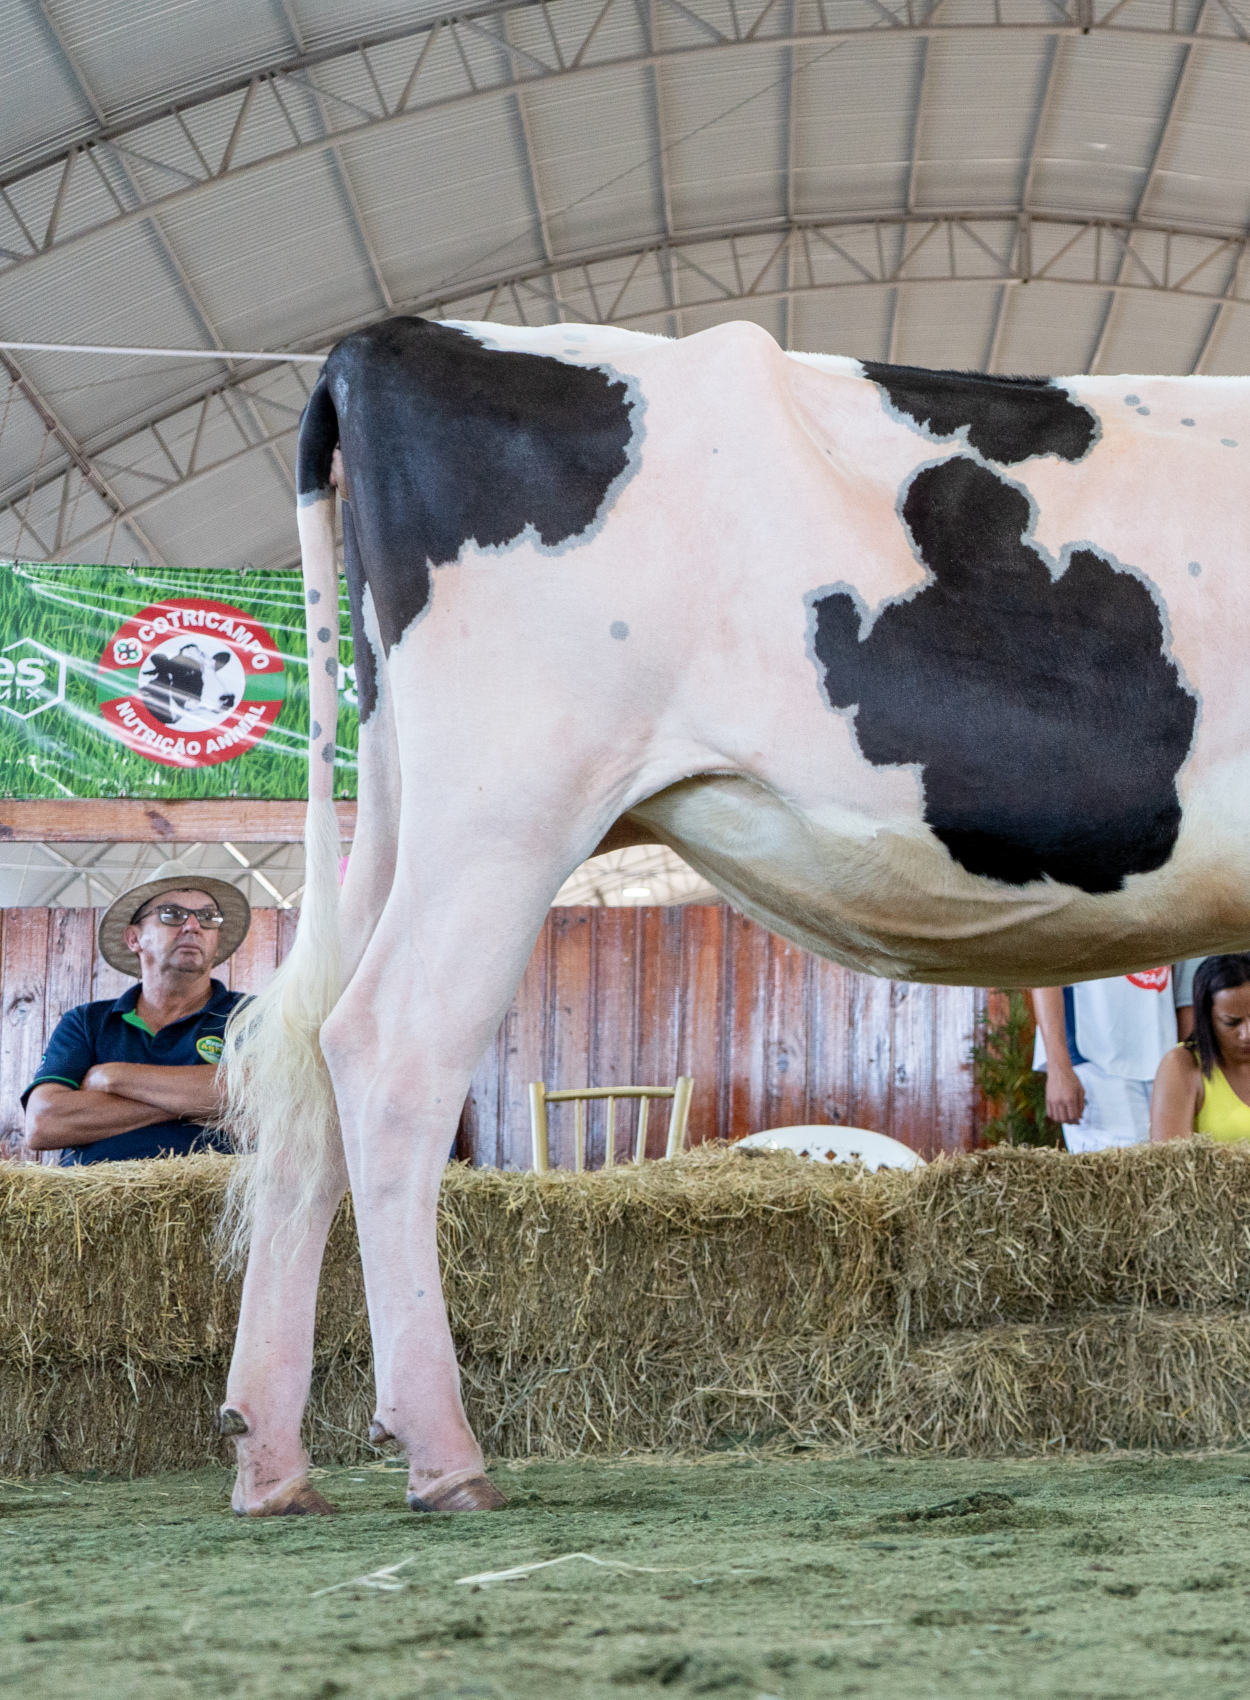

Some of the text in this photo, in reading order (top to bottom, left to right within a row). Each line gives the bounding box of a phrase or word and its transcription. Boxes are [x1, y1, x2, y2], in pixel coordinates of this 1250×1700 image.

[138, 609, 270, 670] COTRICAMPO
[116, 701, 267, 756] NUTRIÇÃO ANIMAL
